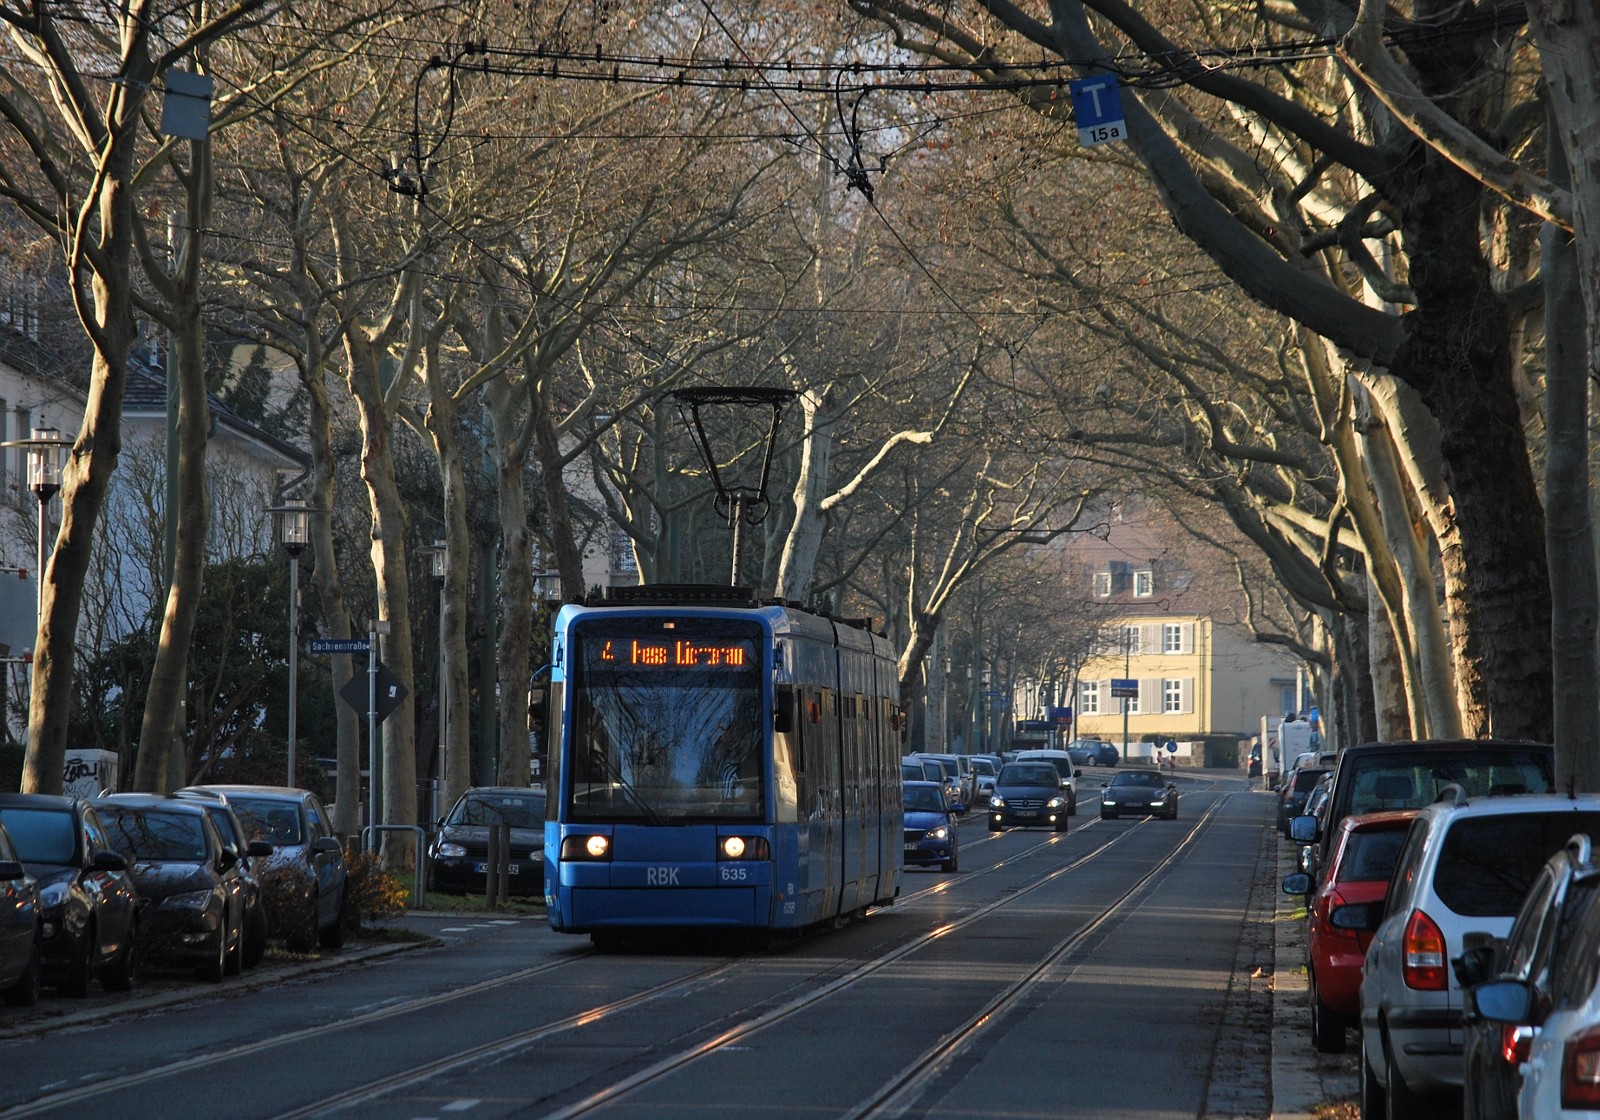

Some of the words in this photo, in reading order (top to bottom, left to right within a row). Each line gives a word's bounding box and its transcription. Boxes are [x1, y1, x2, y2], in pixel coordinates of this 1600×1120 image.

[1082, 82, 1106, 118] T
[312, 641, 367, 651] Sachsenstraße
[647, 867, 680, 885] RBK
[721, 868, 747, 881] 635
